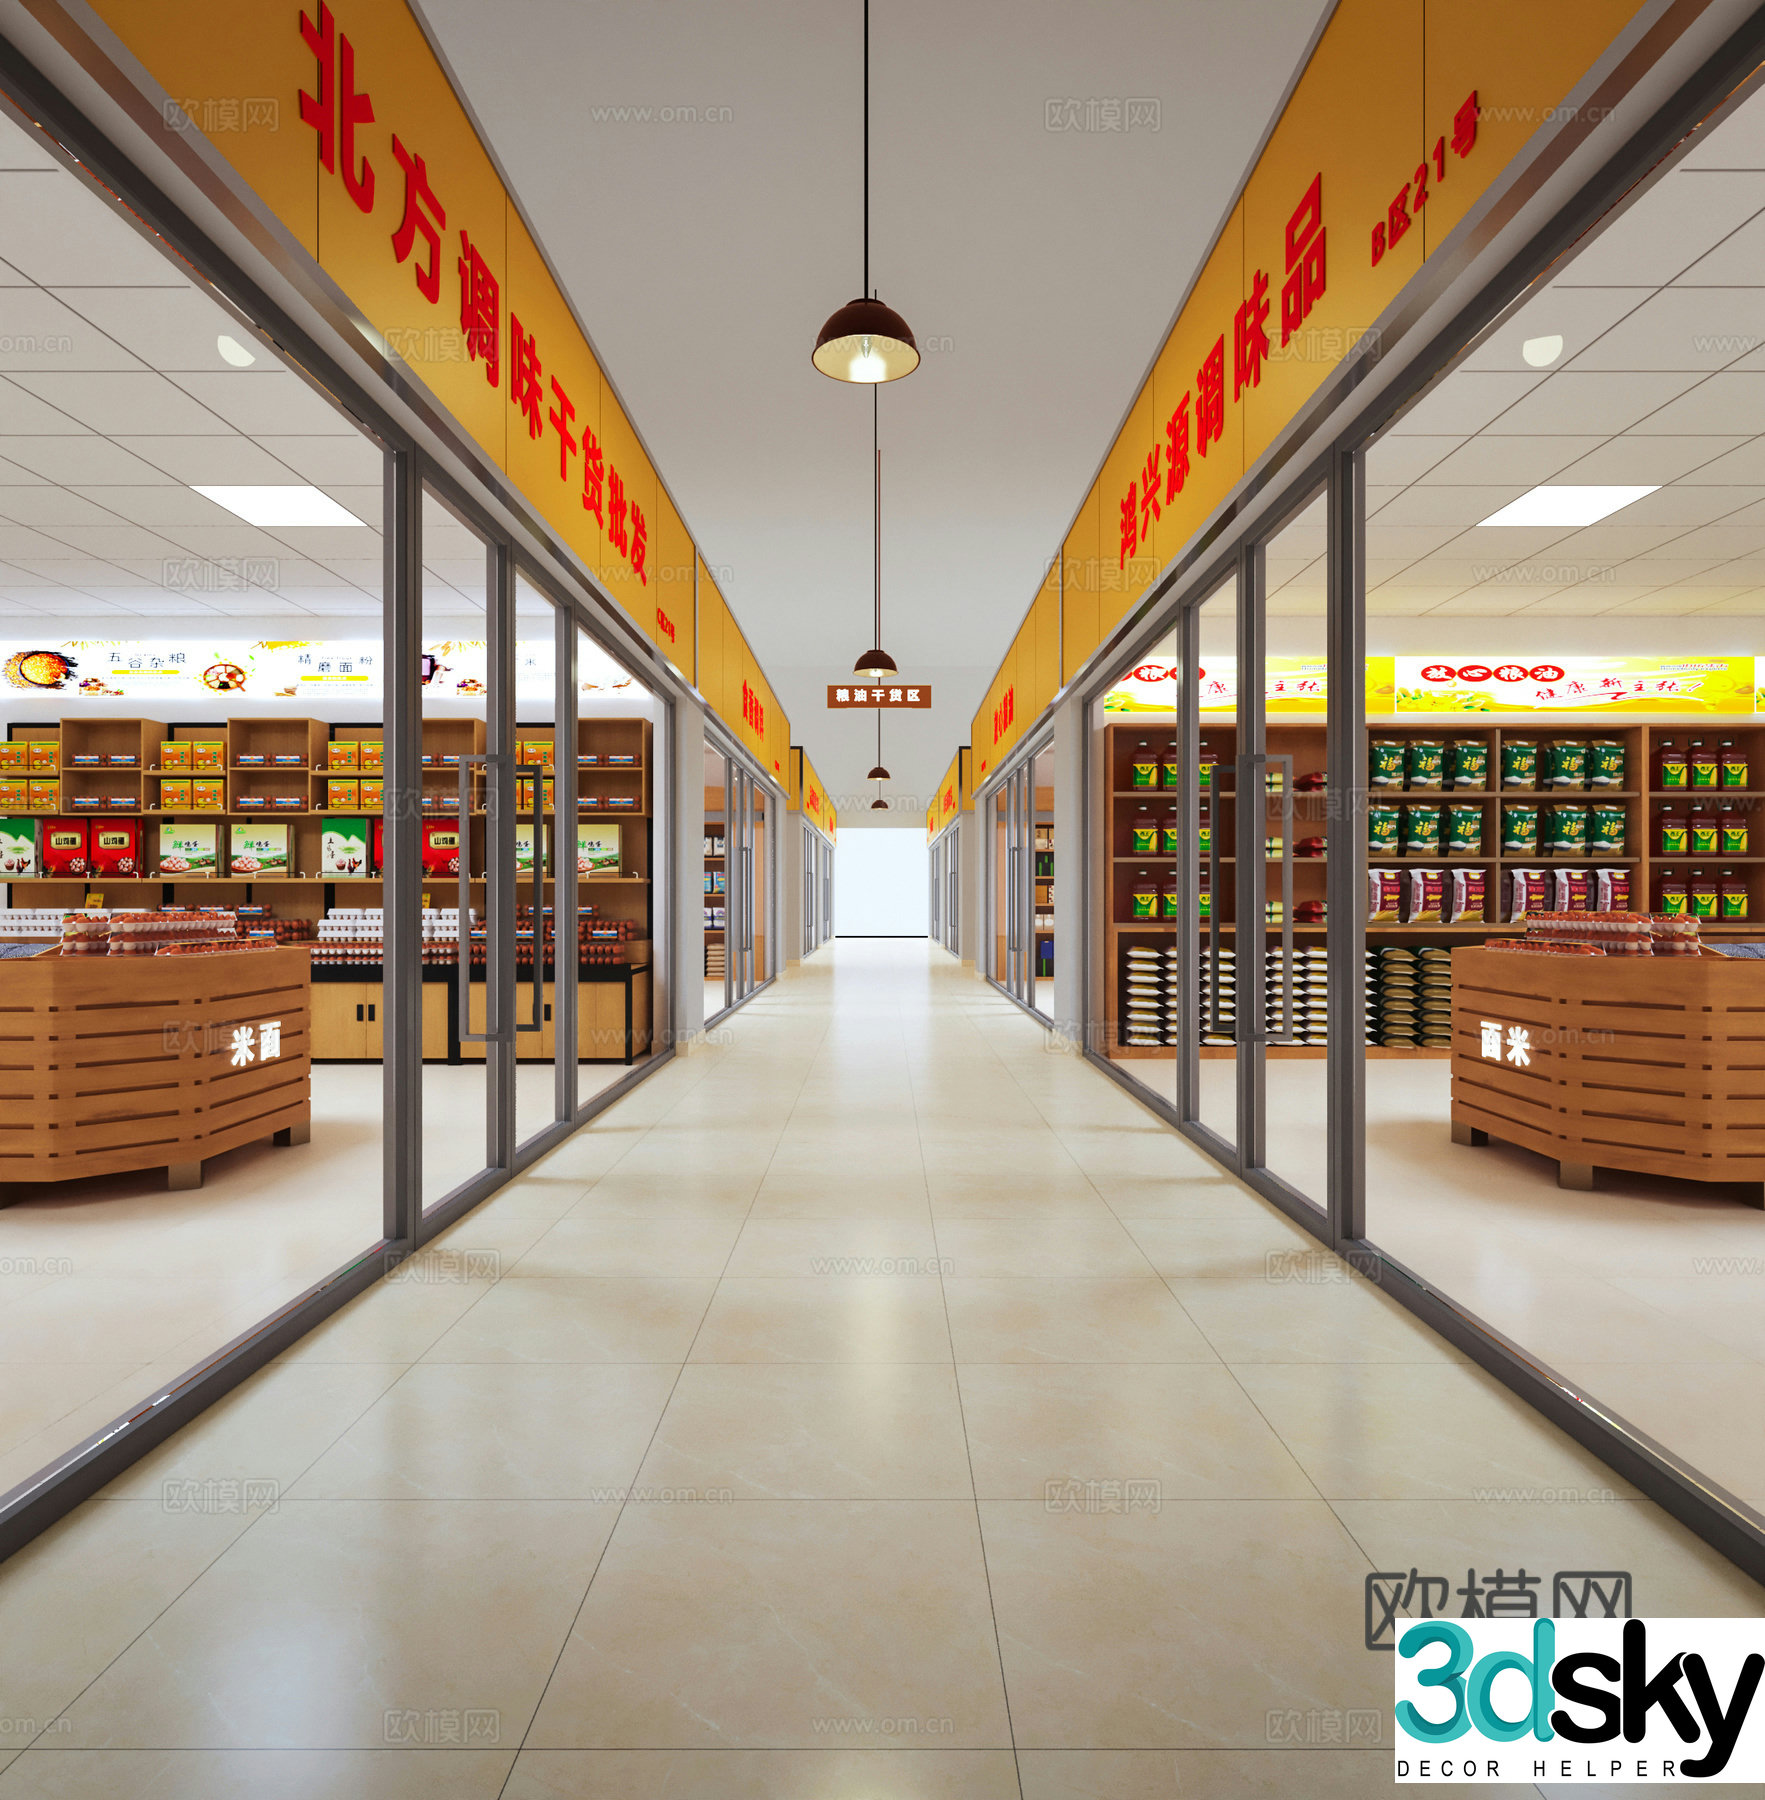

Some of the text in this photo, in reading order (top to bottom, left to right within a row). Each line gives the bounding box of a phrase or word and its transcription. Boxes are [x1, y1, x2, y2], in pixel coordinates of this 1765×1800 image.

[297, 0, 647, 587] 北方调味干货批发
[1119, 90, 1482, 571] 鸿兴源调味品 B区21号
[108, 651, 186, 669] 五谷杂粮
[298, 653, 373, 673] 精磨面粉
[1424, 666, 1560, 682] 放心粮油
[835, 688, 921, 703] 粮油干货区
[231, 1021, 281, 1067] 米面
